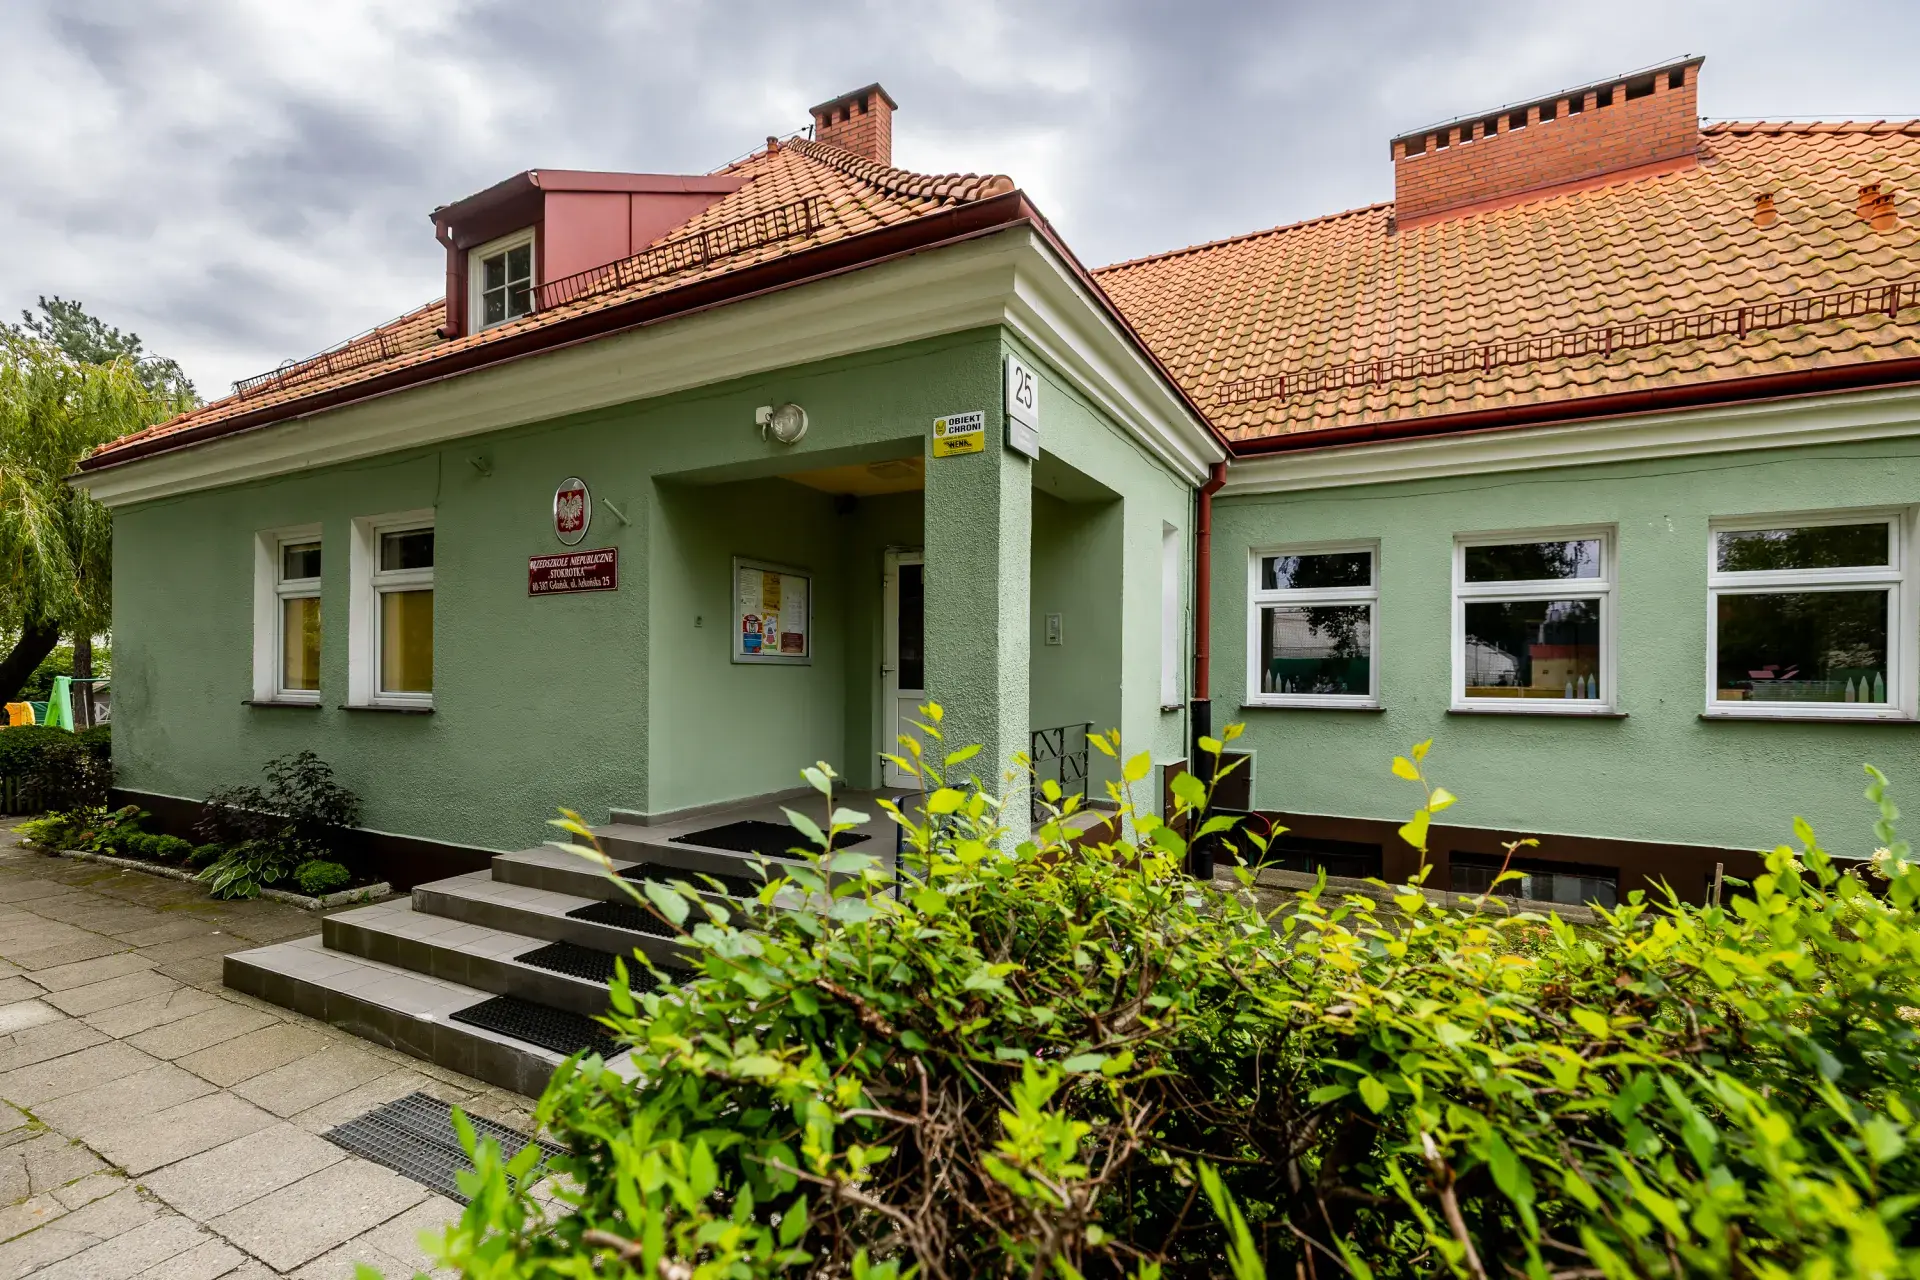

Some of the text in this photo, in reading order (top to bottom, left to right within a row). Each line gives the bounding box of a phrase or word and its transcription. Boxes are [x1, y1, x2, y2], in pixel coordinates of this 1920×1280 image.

[1015, 366, 1033, 409] 25
[948, 414, 981, 426] OBIEKT
[948, 423, 981, 434] CHRONI
[570, 553, 613, 566] NIEPUBLICZNE
[602, 576, 610, 586] 25
